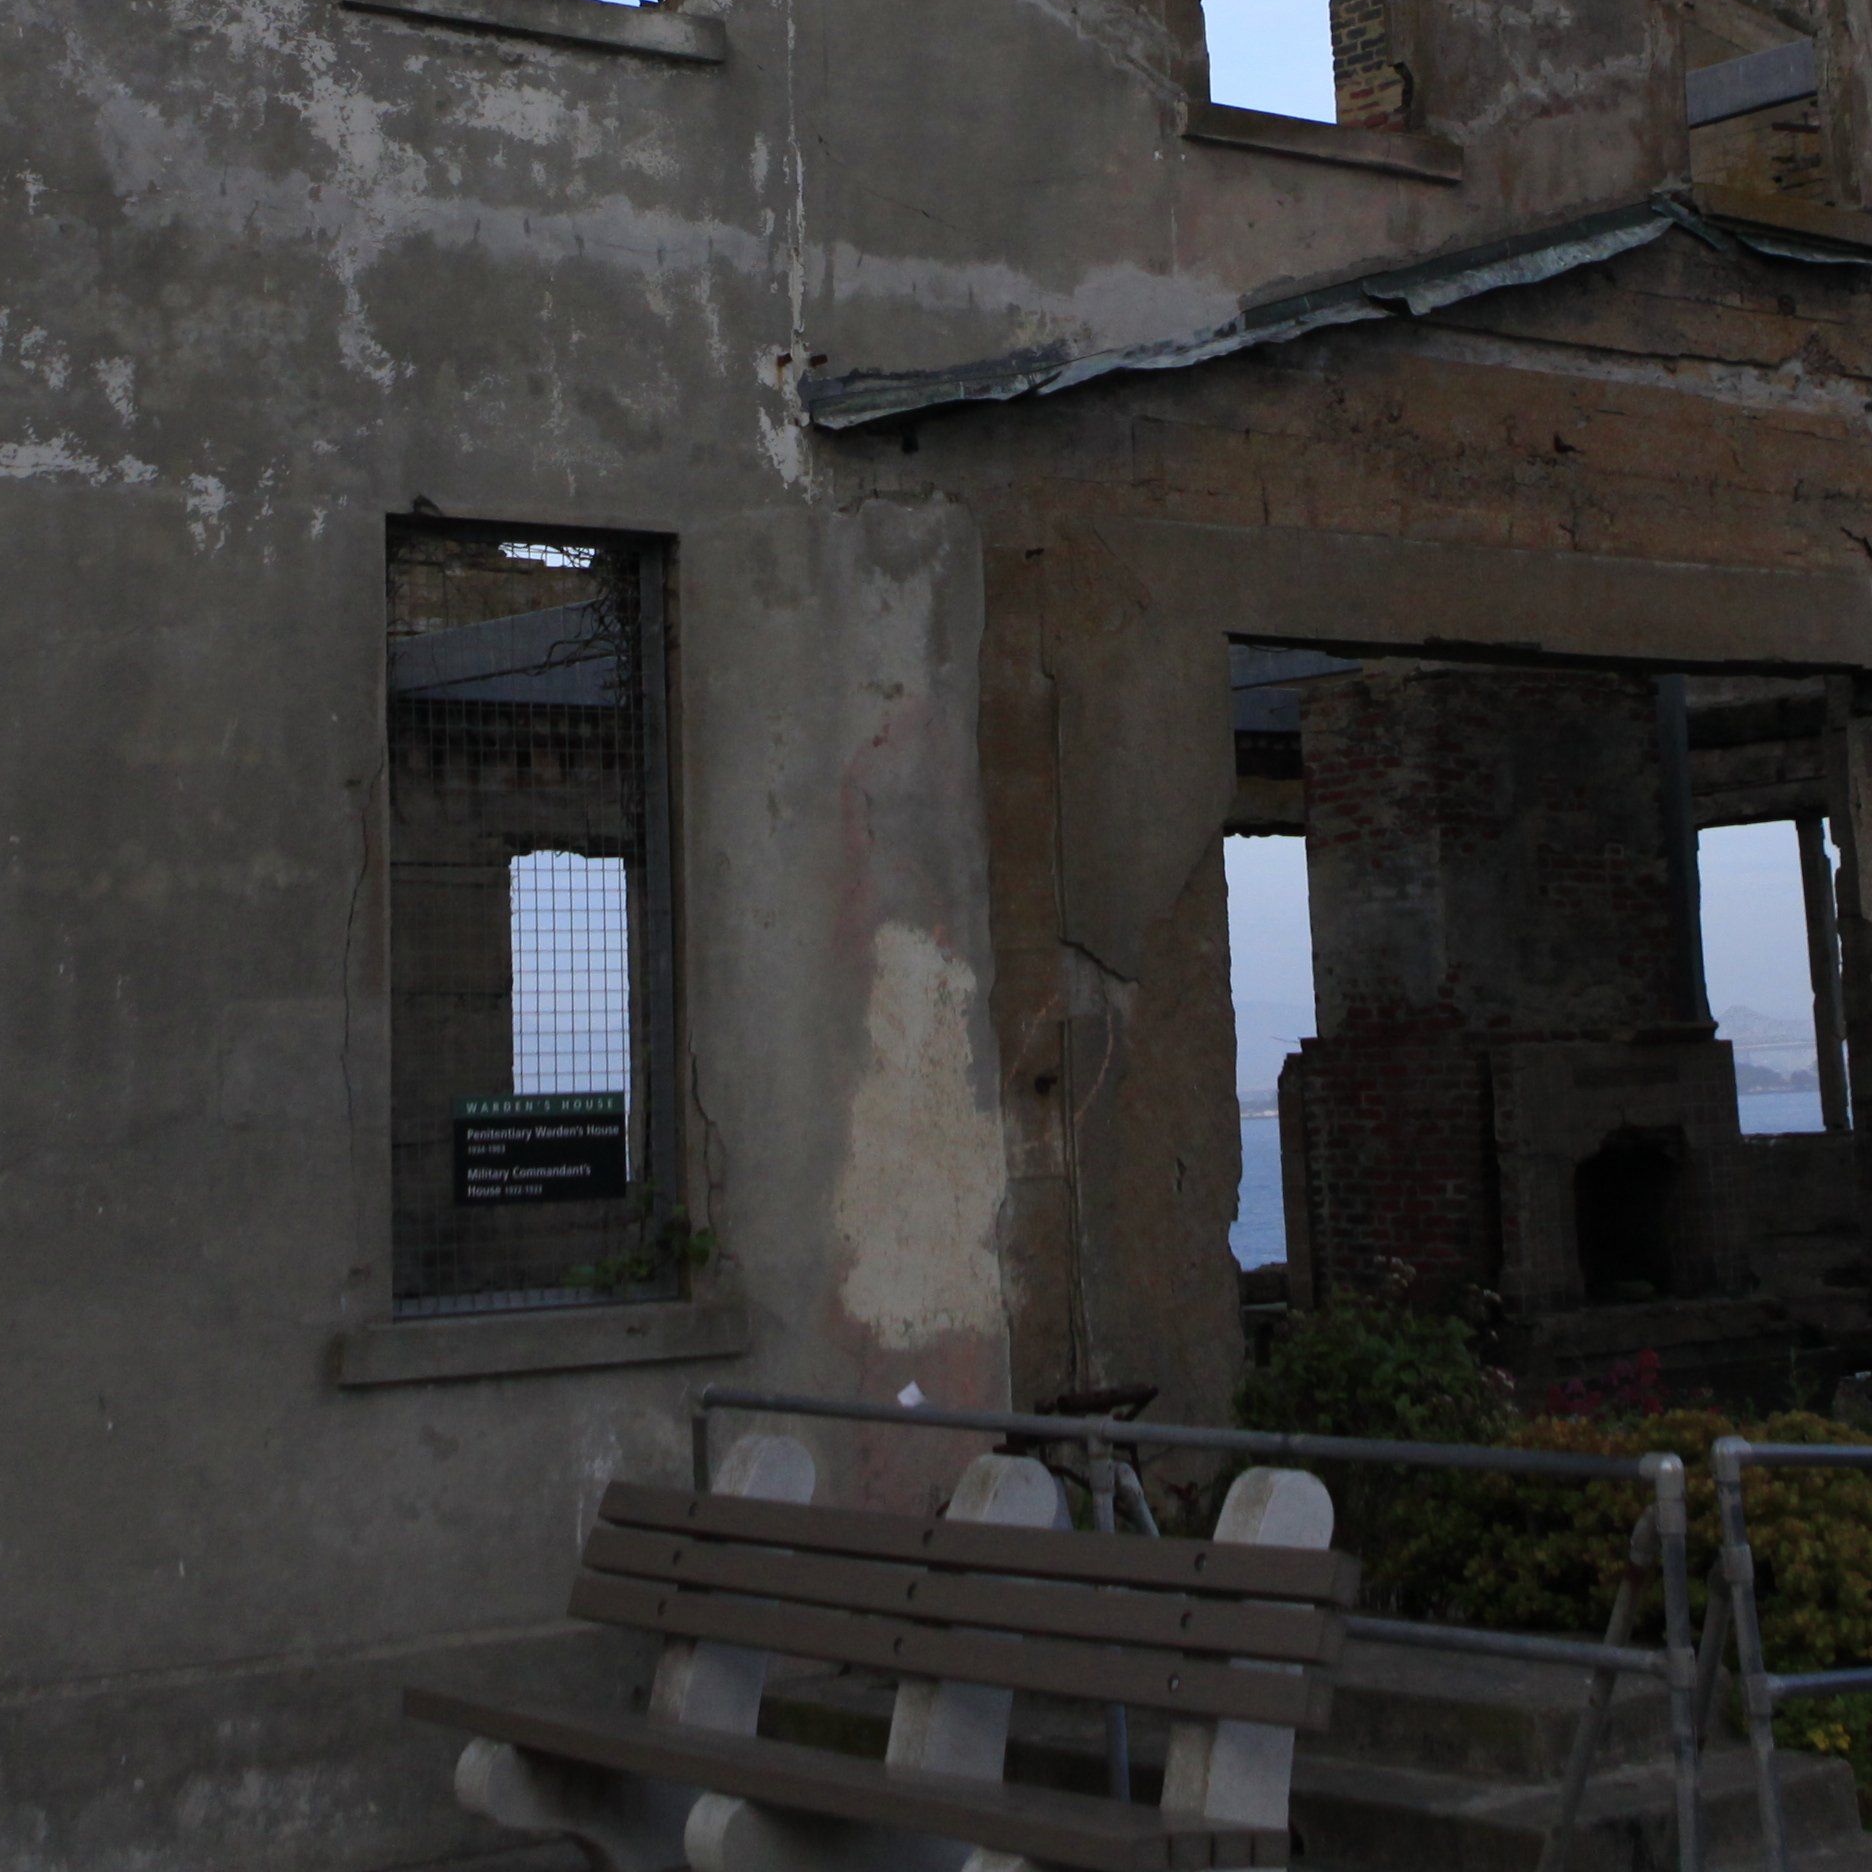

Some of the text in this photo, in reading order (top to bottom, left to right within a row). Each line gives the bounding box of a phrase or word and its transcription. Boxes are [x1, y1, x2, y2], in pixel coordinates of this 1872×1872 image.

[466, 1098, 615, 1115] WARDEN'S HOUSE
[467, 1124, 620, 1142] Penitentiary Warden's House
[467, 1163, 591, 1182] Military Commandant's
[467, 1184, 502, 1198] House
